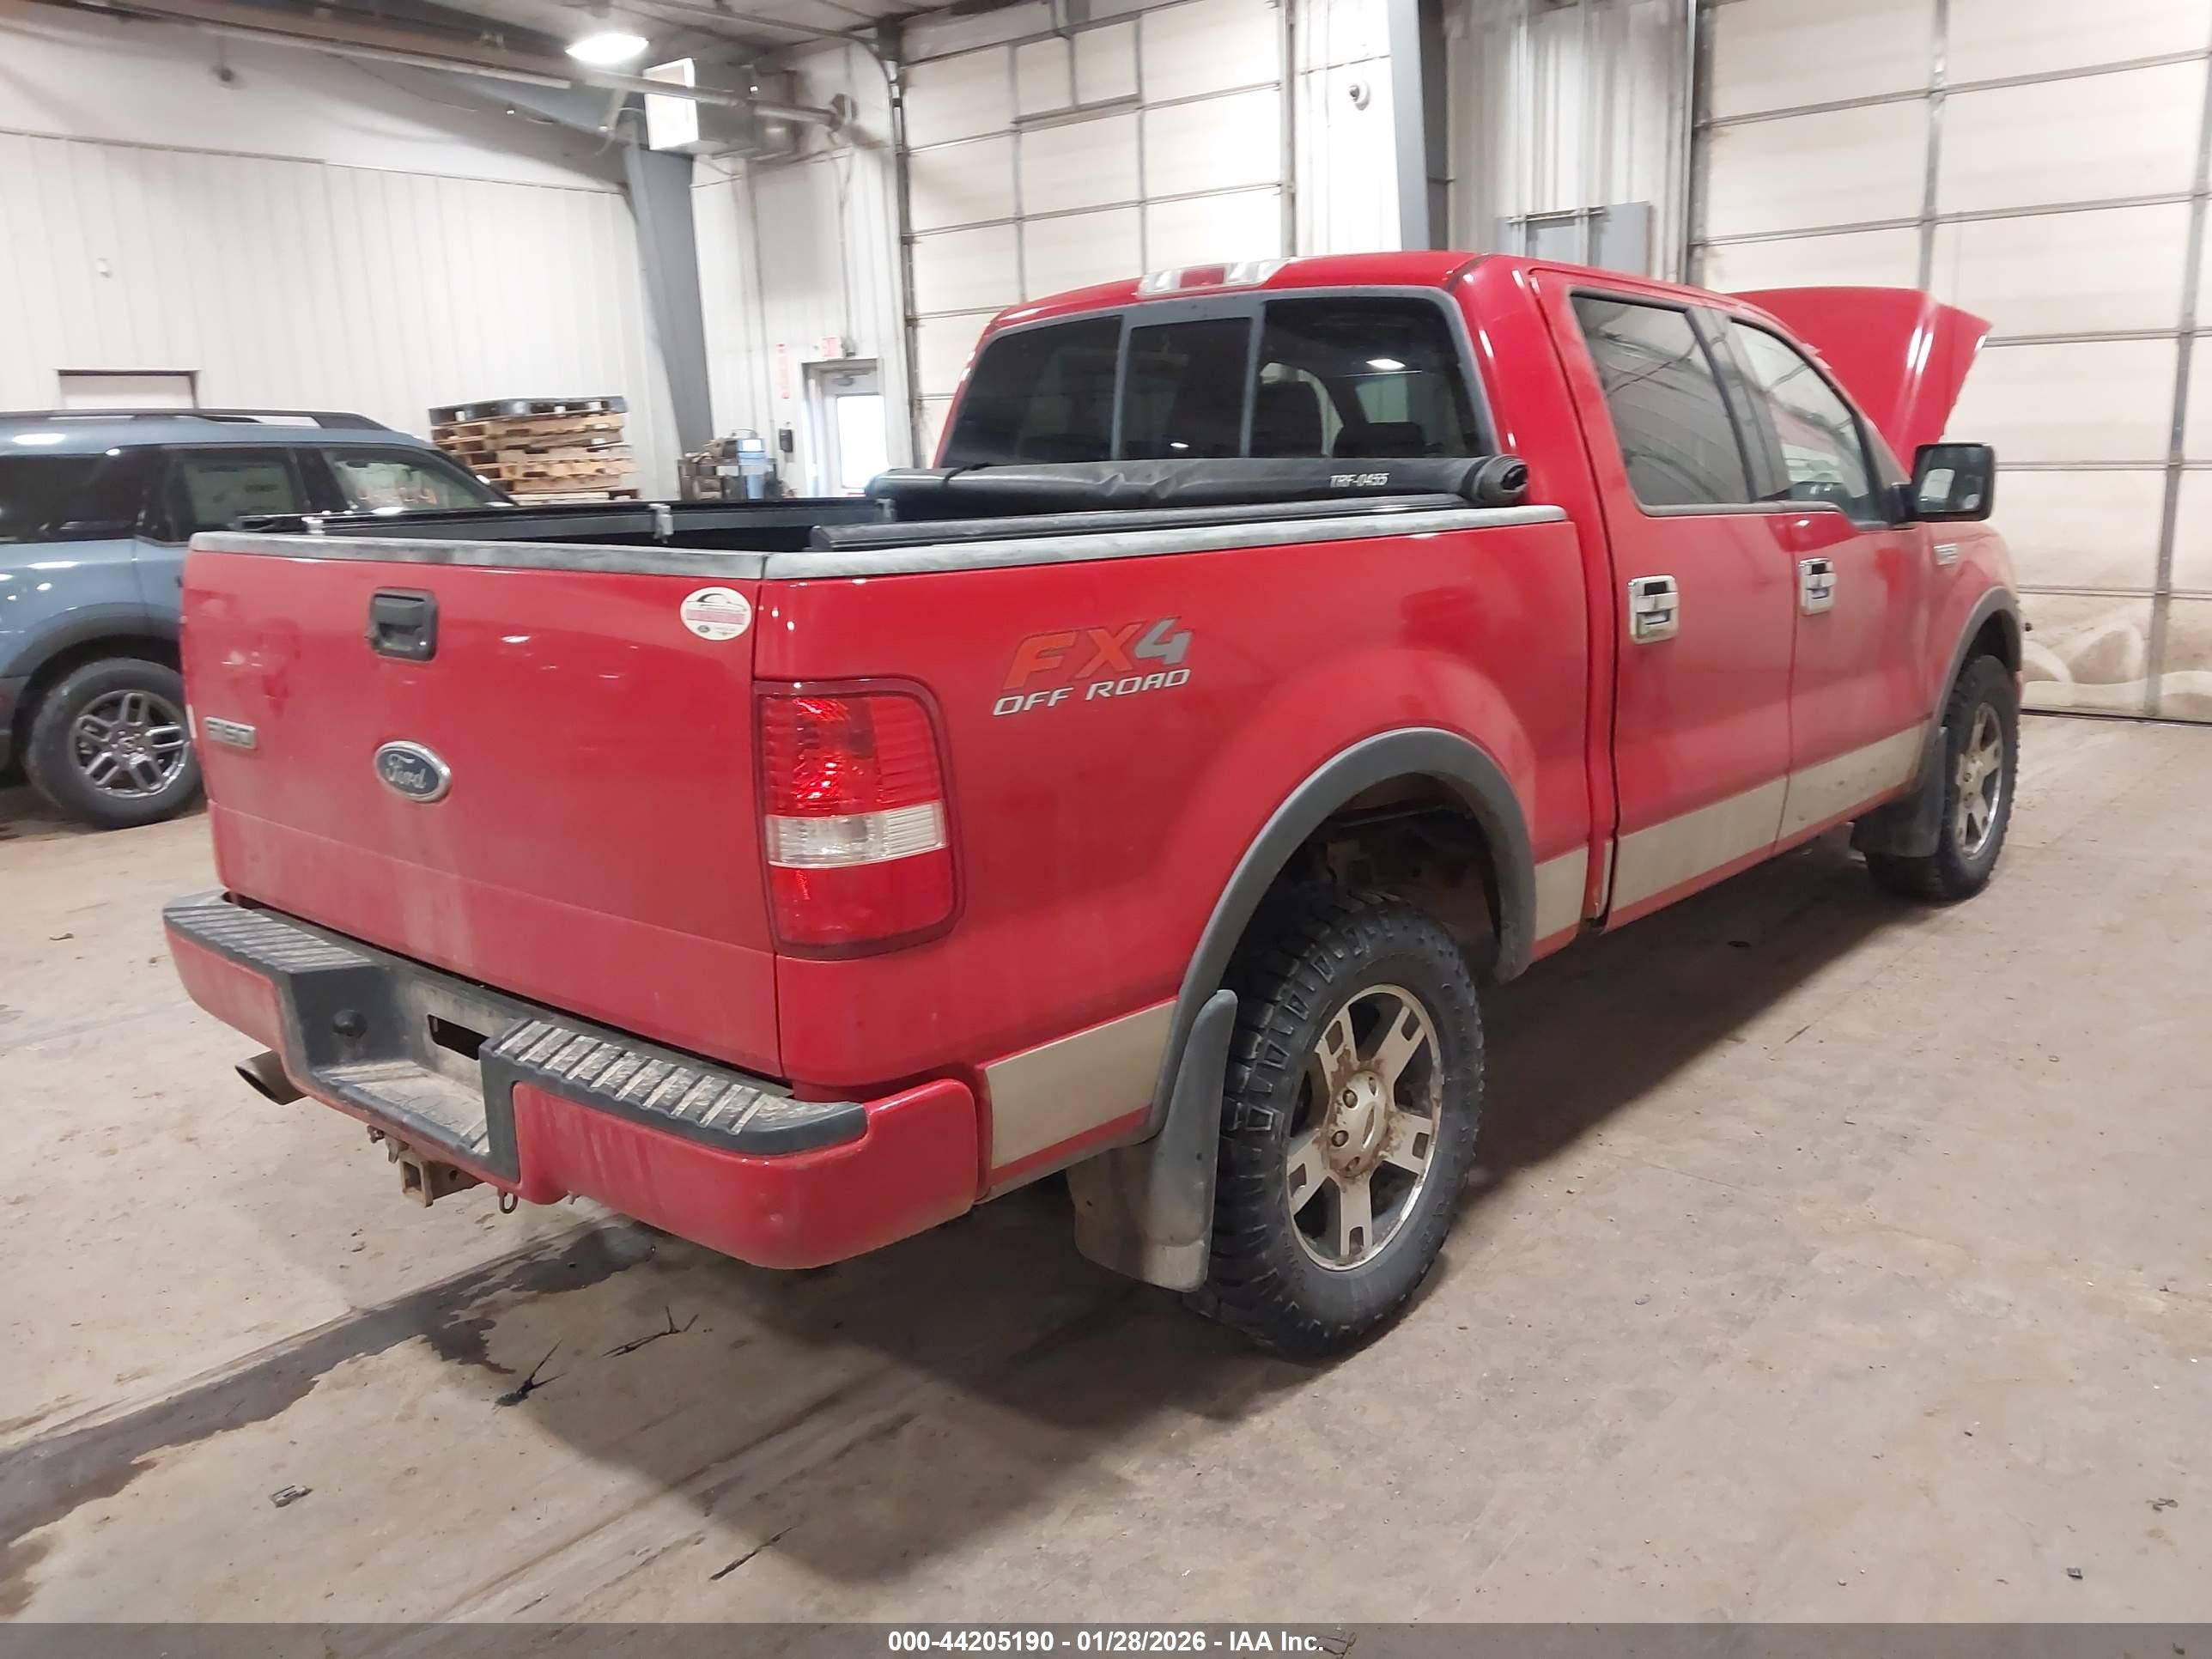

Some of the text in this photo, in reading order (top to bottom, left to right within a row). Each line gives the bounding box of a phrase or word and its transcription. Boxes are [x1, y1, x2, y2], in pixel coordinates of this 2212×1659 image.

[1001, 617, 1194, 690] FX4
[993, 668, 1192, 716] OFF ROAD
[385, 753, 427, 789] Ford
